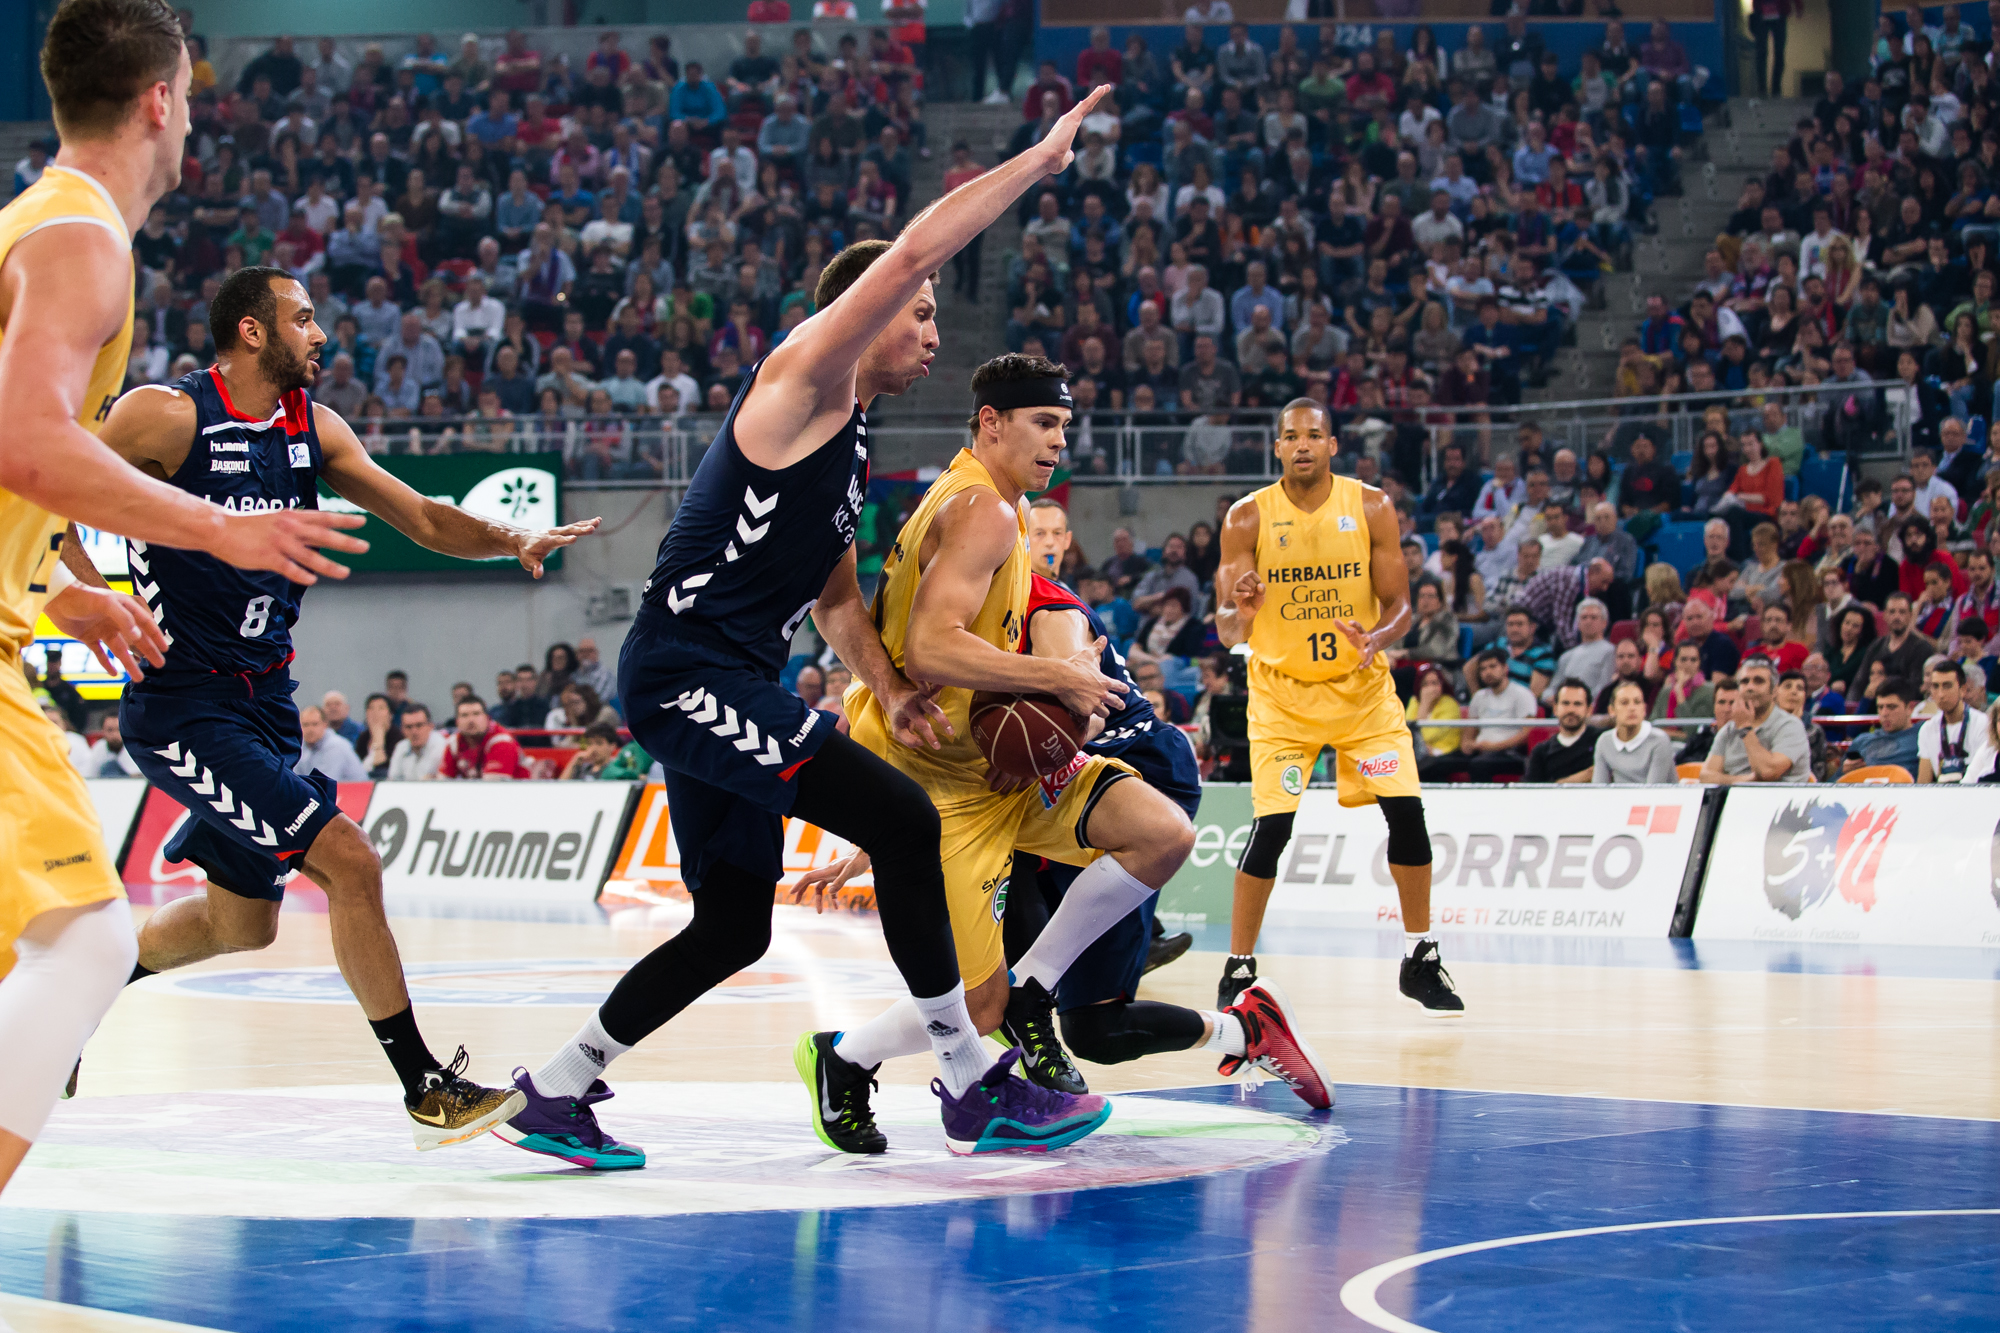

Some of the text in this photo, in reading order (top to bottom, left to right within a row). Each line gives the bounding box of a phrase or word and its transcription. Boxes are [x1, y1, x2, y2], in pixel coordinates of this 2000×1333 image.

[210, 440, 250, 453] hummel
[209, 459, 251, 472] BASKONIA
[1268, 562, 1362, 583] HERBALIFE
[1291, 585, 1339, 604] Gran
[239, 594, 275, 638] 8
[1280, 600, 1354, 621] Canaria
[1307, 632, 1338, 662] 13
[788, 708, 820, 748] hummel
[284, 797, 320, 837] hummel
[408, 808, 604, 881] hummel
[1283, 834, 1356, 885] EL
[1377, 906, 1626, 928] PAE DE TI ZURE BAITAN
